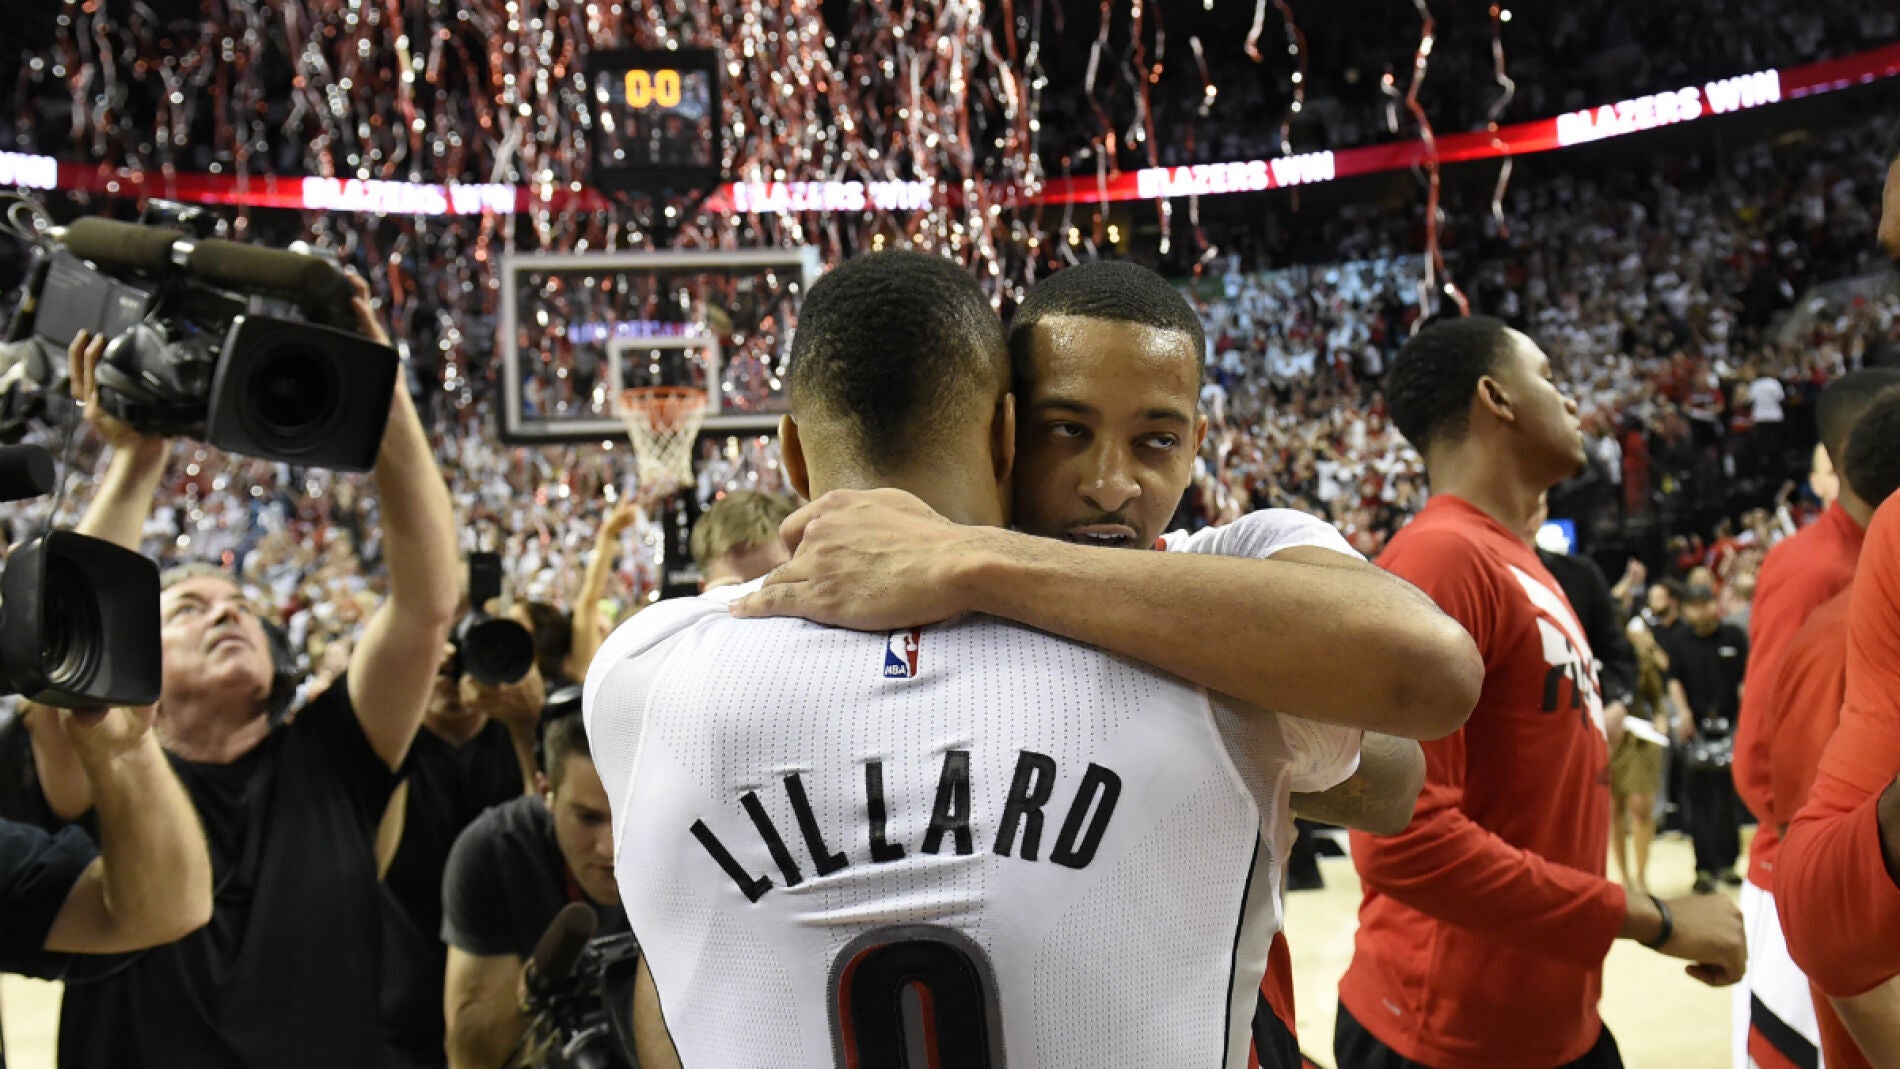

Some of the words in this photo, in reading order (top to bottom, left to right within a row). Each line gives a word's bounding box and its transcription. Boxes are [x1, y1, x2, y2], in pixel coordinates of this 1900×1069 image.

[1557, 87, 1702, 146] BLAZERS
[1705, 69, 1780, 114] WIN
[302, 176, 447, 215] BLAZERS
[450, 183, 515, 214] WIN
[868, 181, 931, 211] WIN
[1137, 160, 1268, 198] BLAZERS
[1271, 151, 1335, 187] WIN
[884, 664, 906, 675] NBA
[689, 750, 1121, 903] LILLARD
